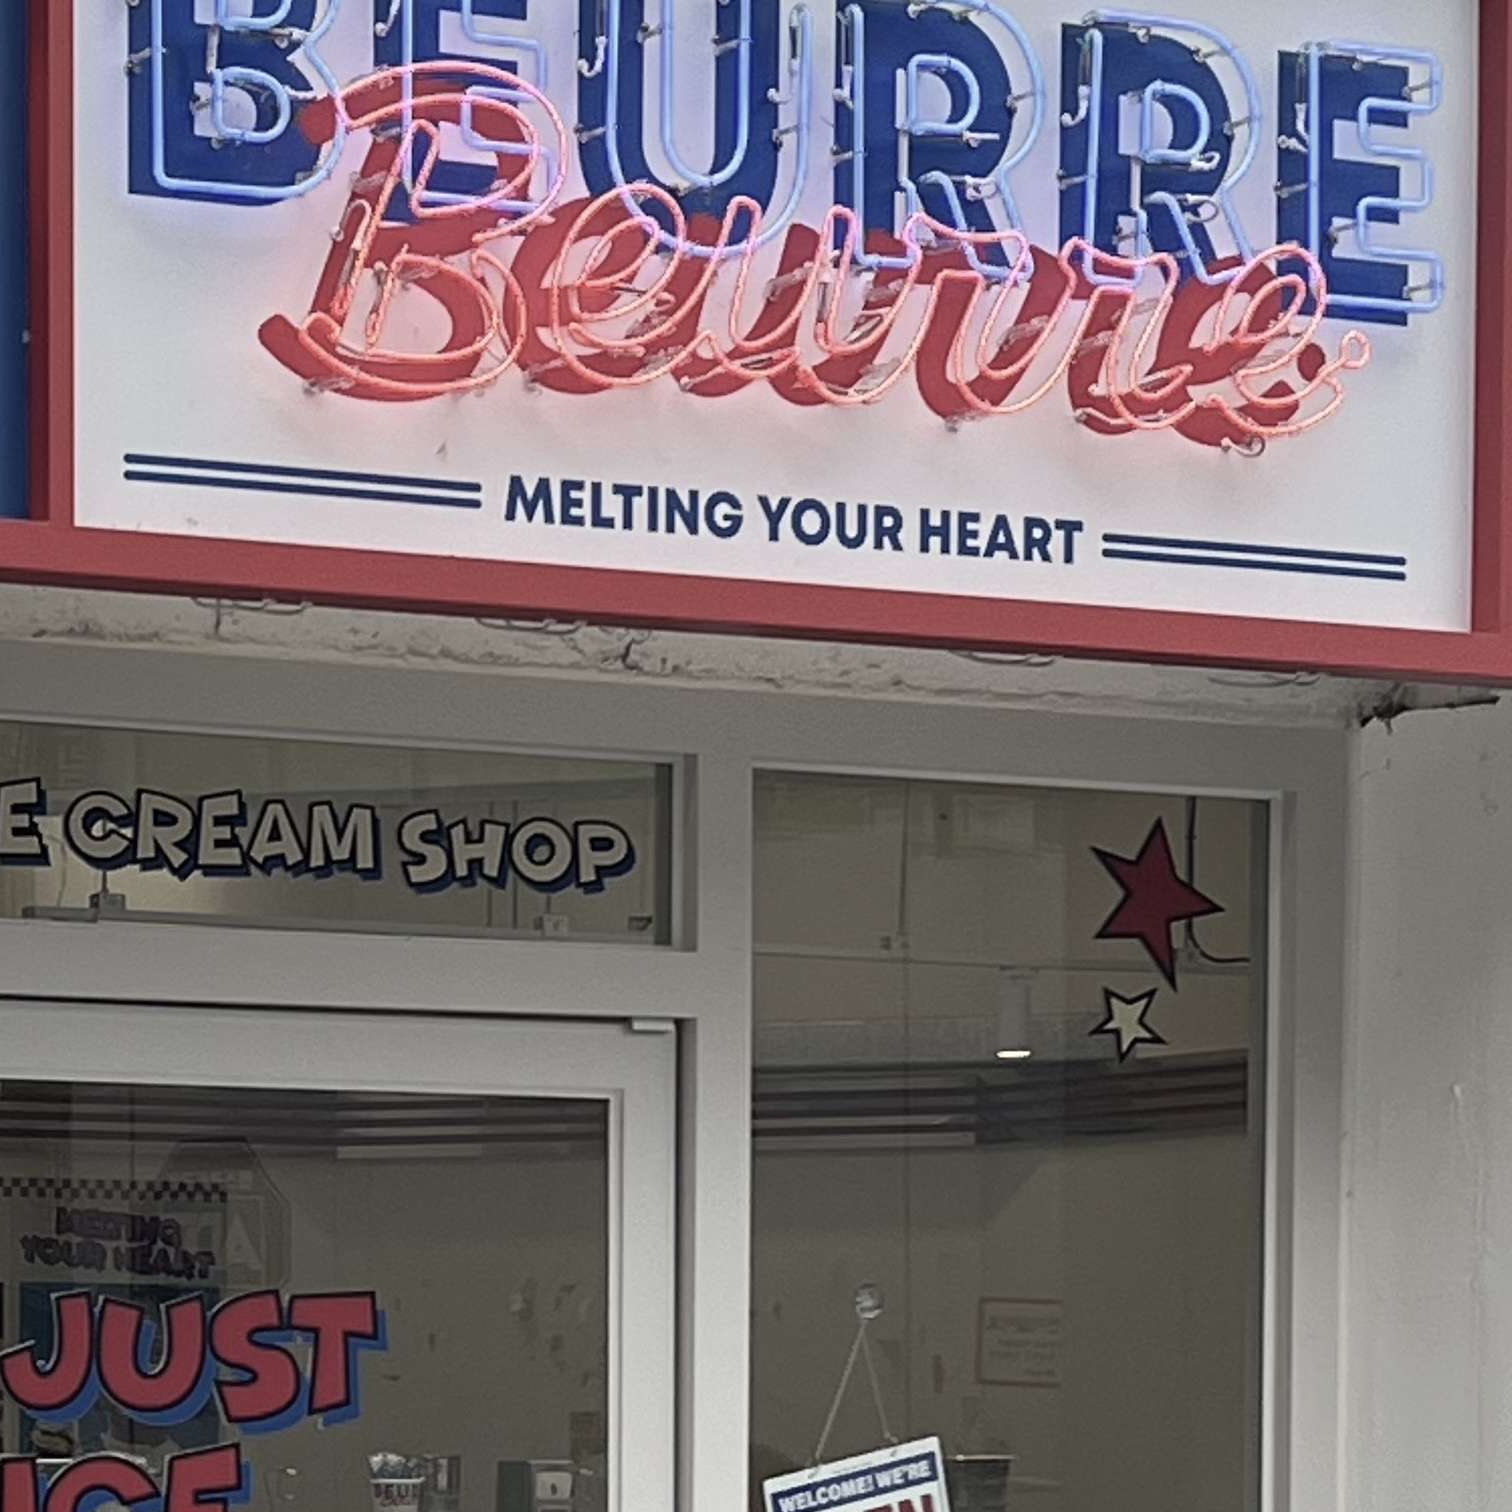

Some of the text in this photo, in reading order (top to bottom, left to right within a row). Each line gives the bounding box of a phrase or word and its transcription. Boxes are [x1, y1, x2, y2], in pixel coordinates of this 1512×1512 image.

[128, 0, 1444, 327] BEURRE
[257, 58, 1371, 450] Beurre
[504, 475, 1084, 565] MELTING YOUR HEART
[64, 788, 381, 881] CREAM
[398, 808, 636, 894] SHOP
[875, 1460, 932, 1488] WE'RE
